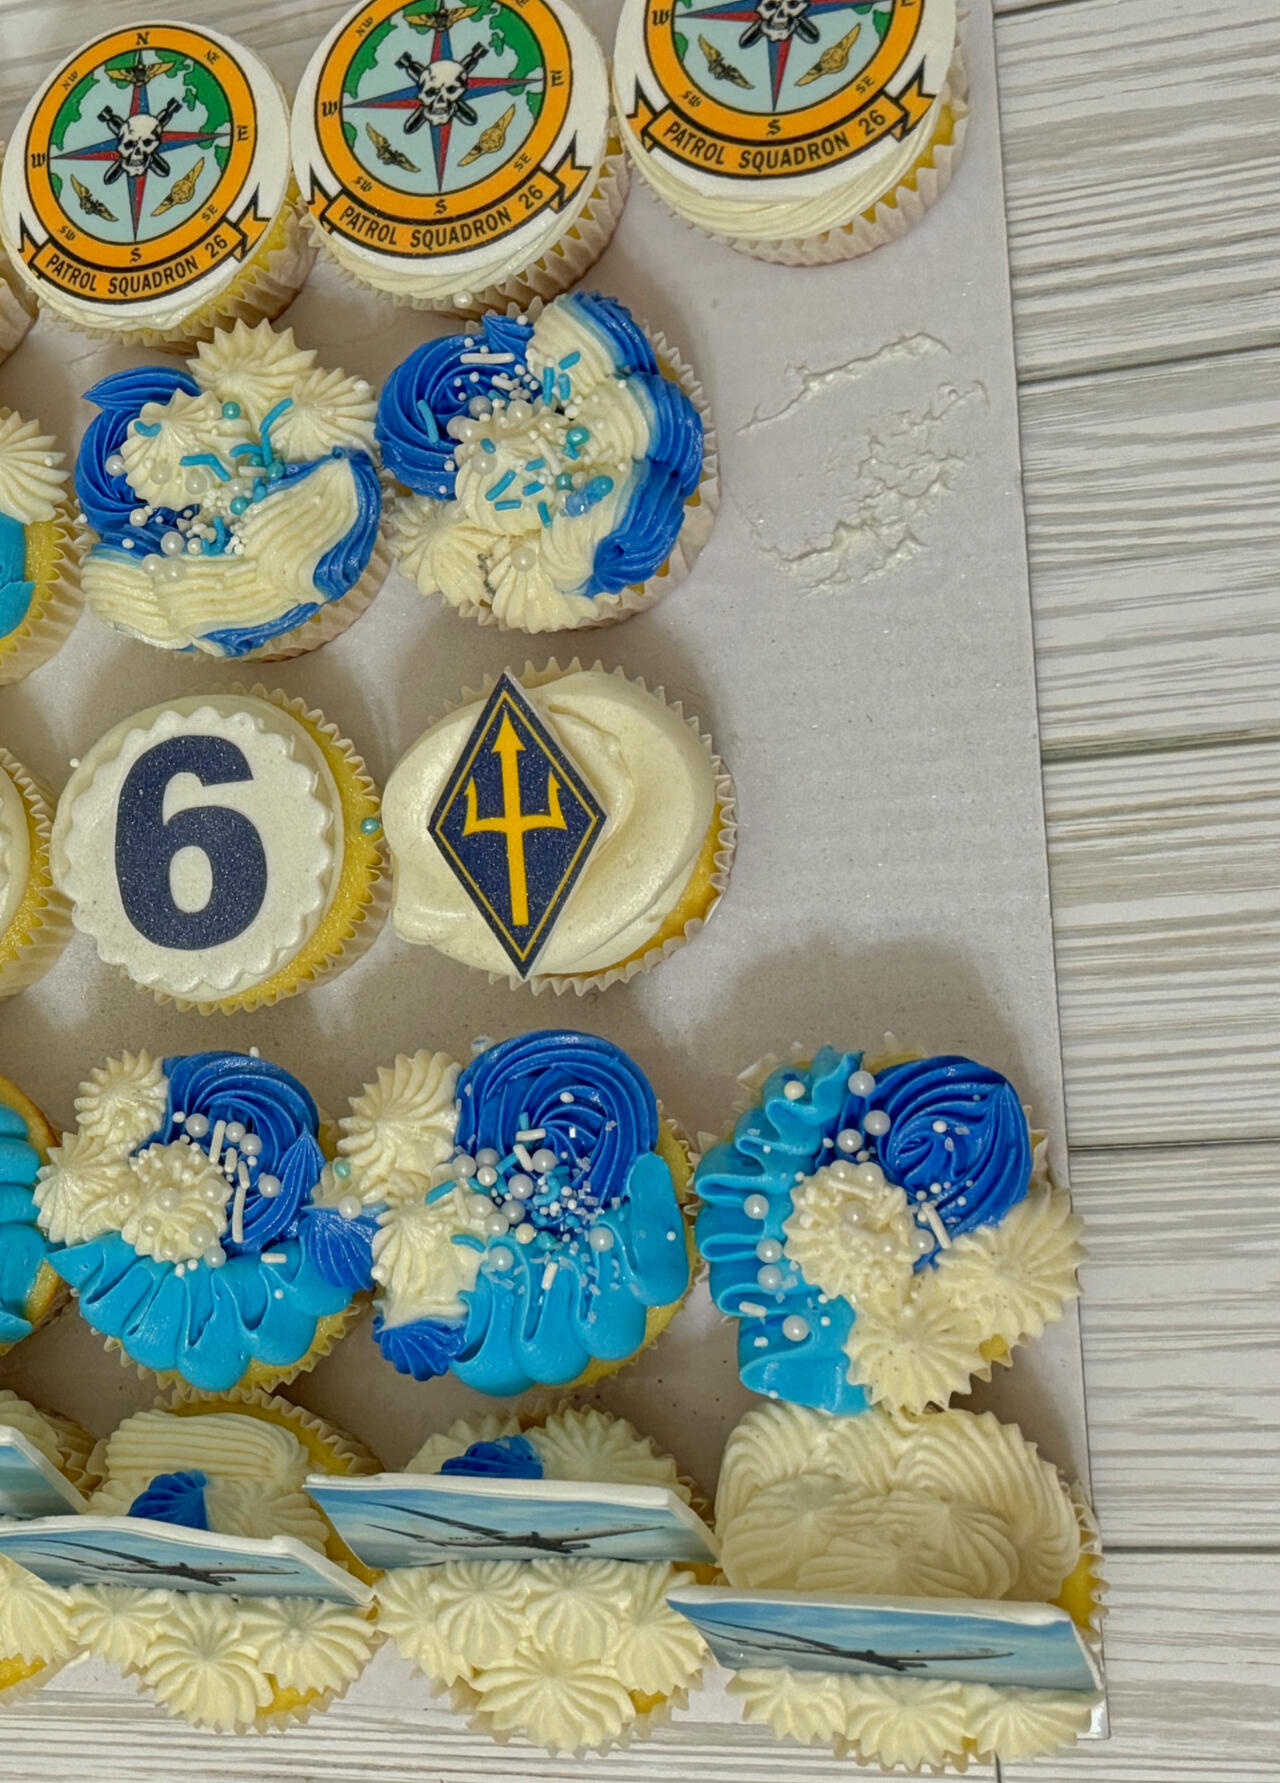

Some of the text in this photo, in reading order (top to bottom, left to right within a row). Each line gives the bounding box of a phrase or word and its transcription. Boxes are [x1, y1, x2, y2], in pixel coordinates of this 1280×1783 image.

[136, 33, 149, 45] N
[62, 71, 78, 90] NW
[551, 71, 564, 87] E
[855, 76, 874, 95] SE
[681, 90, 701, 107] SW
[237, 125, 248, 141] E
[766, 119, 781, 136] S
[663, 110, 886, 172] PATROL SQUADRON 26
[514, 153, 531, 171] SE
[354, 176, 372, 193] SW
[202, 205, 217, 222] SE
[434, 199, 447, 215] S
[339, 185, 543, 250] PATROL SQUADRON 26
[59, 226, 75, 241] SW
[130, 248, 141, 263] S
[45, 235, 227, 294] PATROL SQUADRON 26
